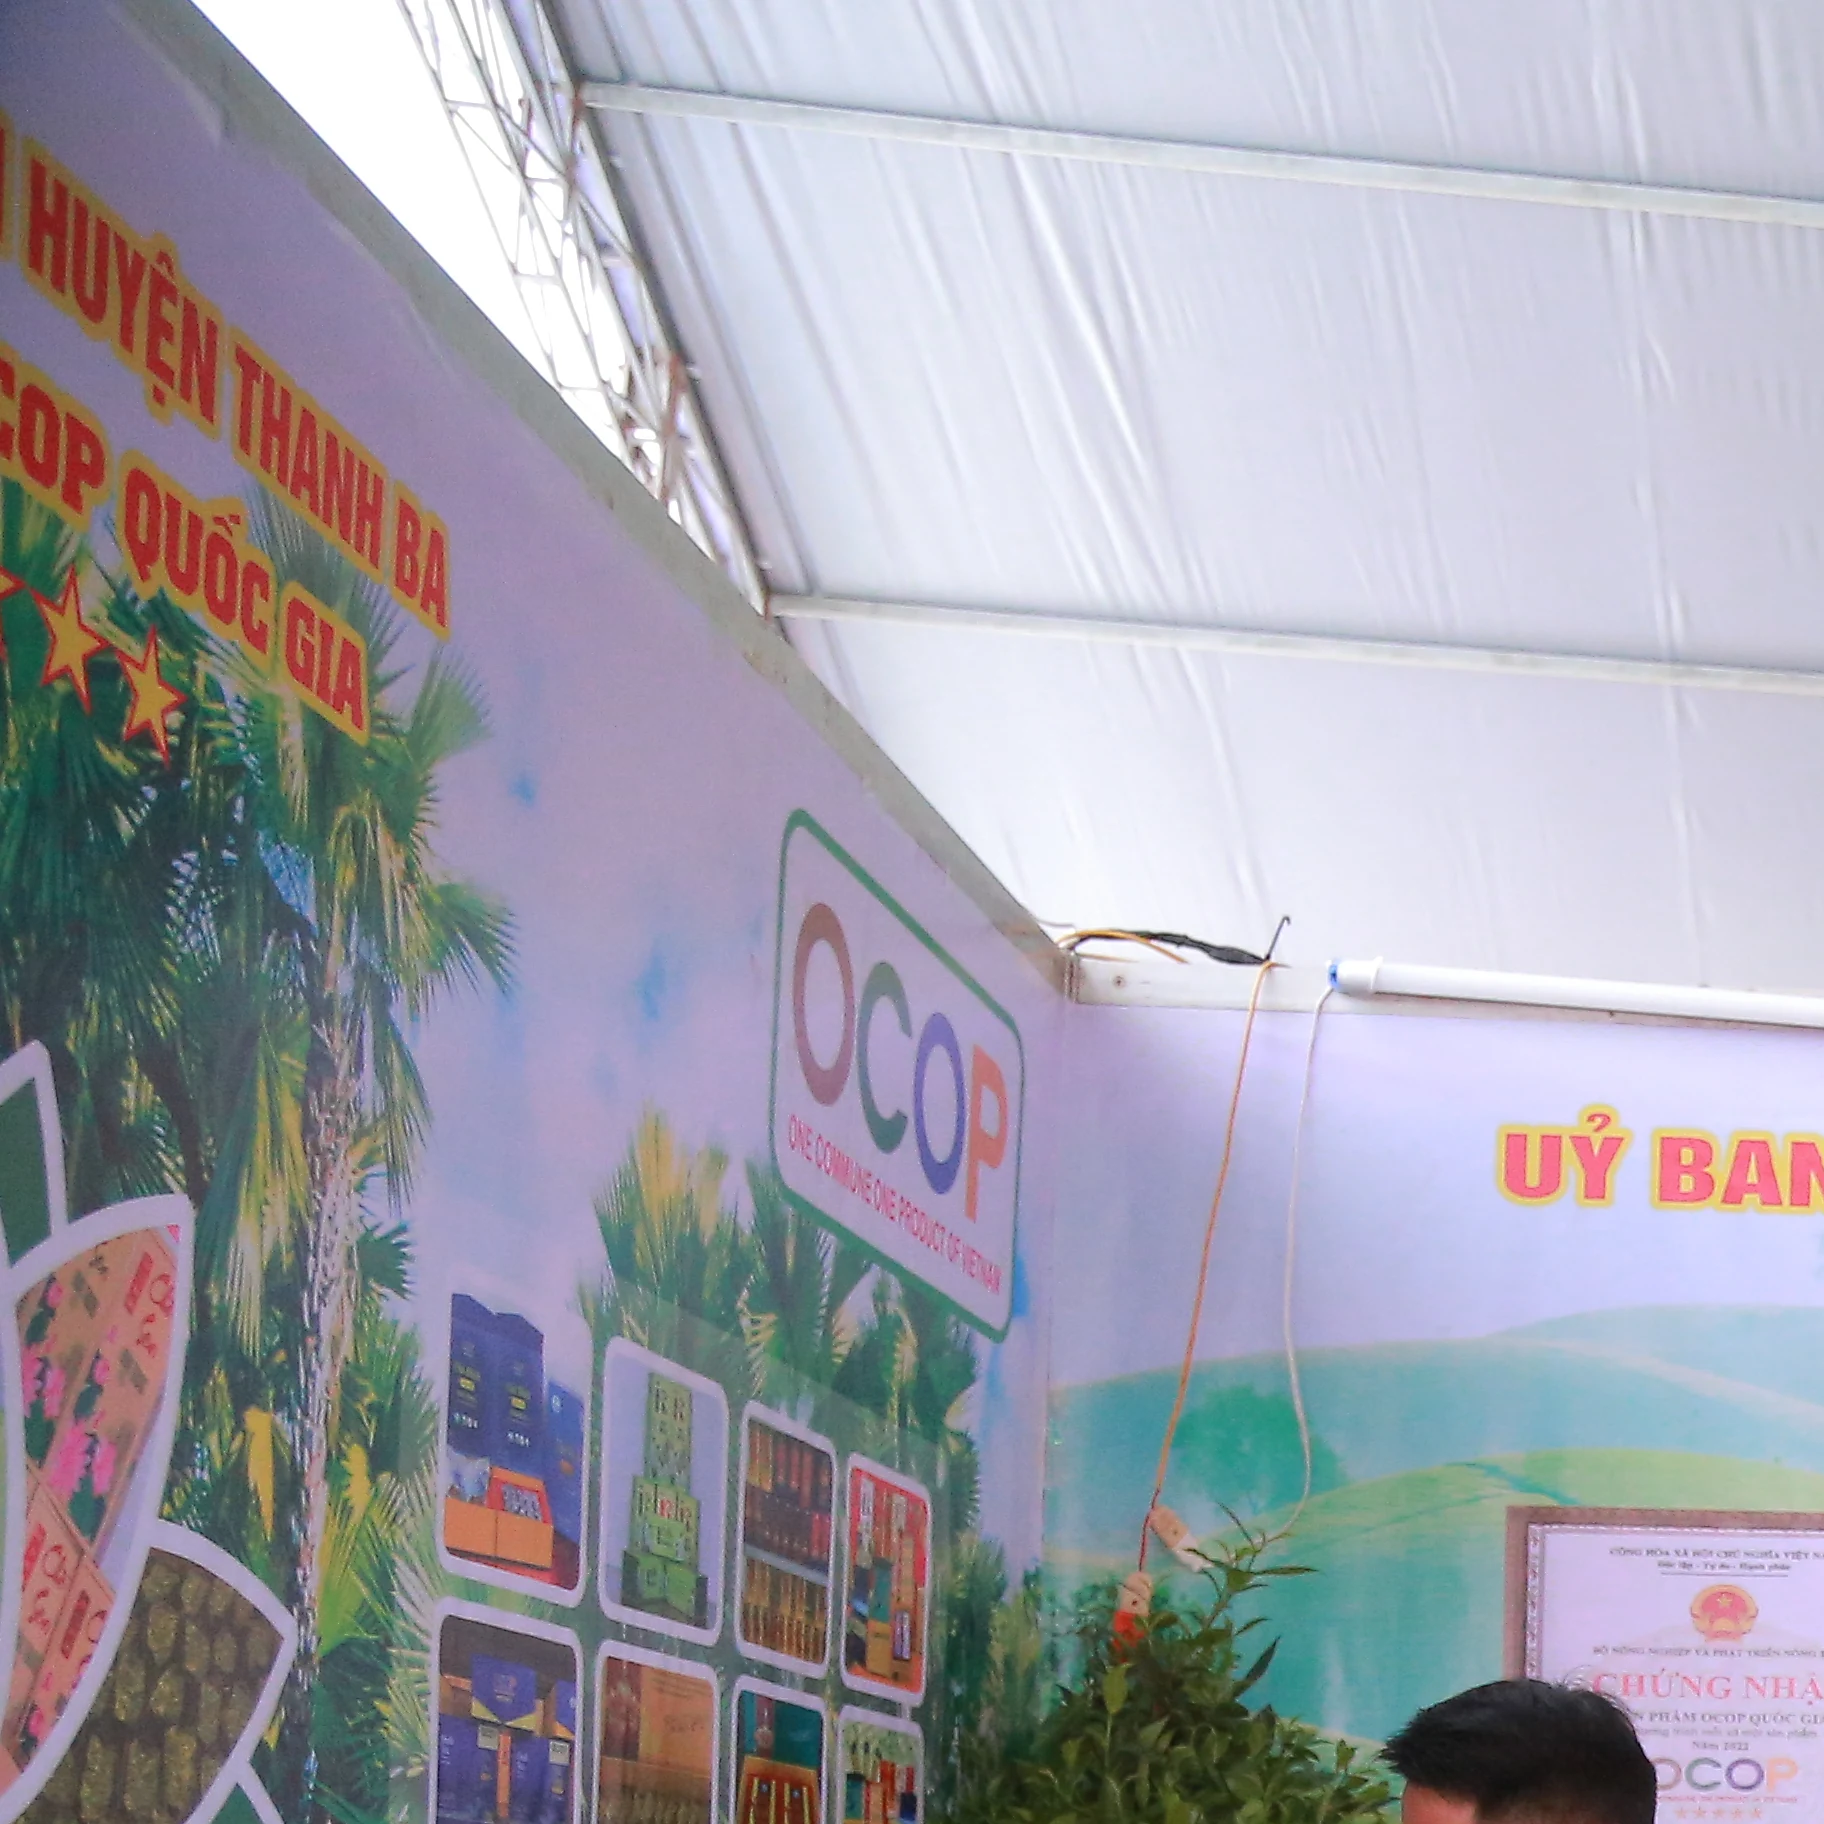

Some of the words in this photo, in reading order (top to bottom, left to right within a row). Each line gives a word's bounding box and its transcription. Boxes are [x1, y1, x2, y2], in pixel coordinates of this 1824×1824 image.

[29, 155, 219, 425] HUYỆN
[234, 352, 383, 574] THANH
[393, 492, 448, 631] BA
[125, 471, 269, 655] QUỐC
[283, 591, 365, 730] GIA
[792, 903, 1008, 1224] OCOP
[1502, 1112, 1625, 1201] UỶ
[1592, 1668, 1732, 1700] CHỨNG
